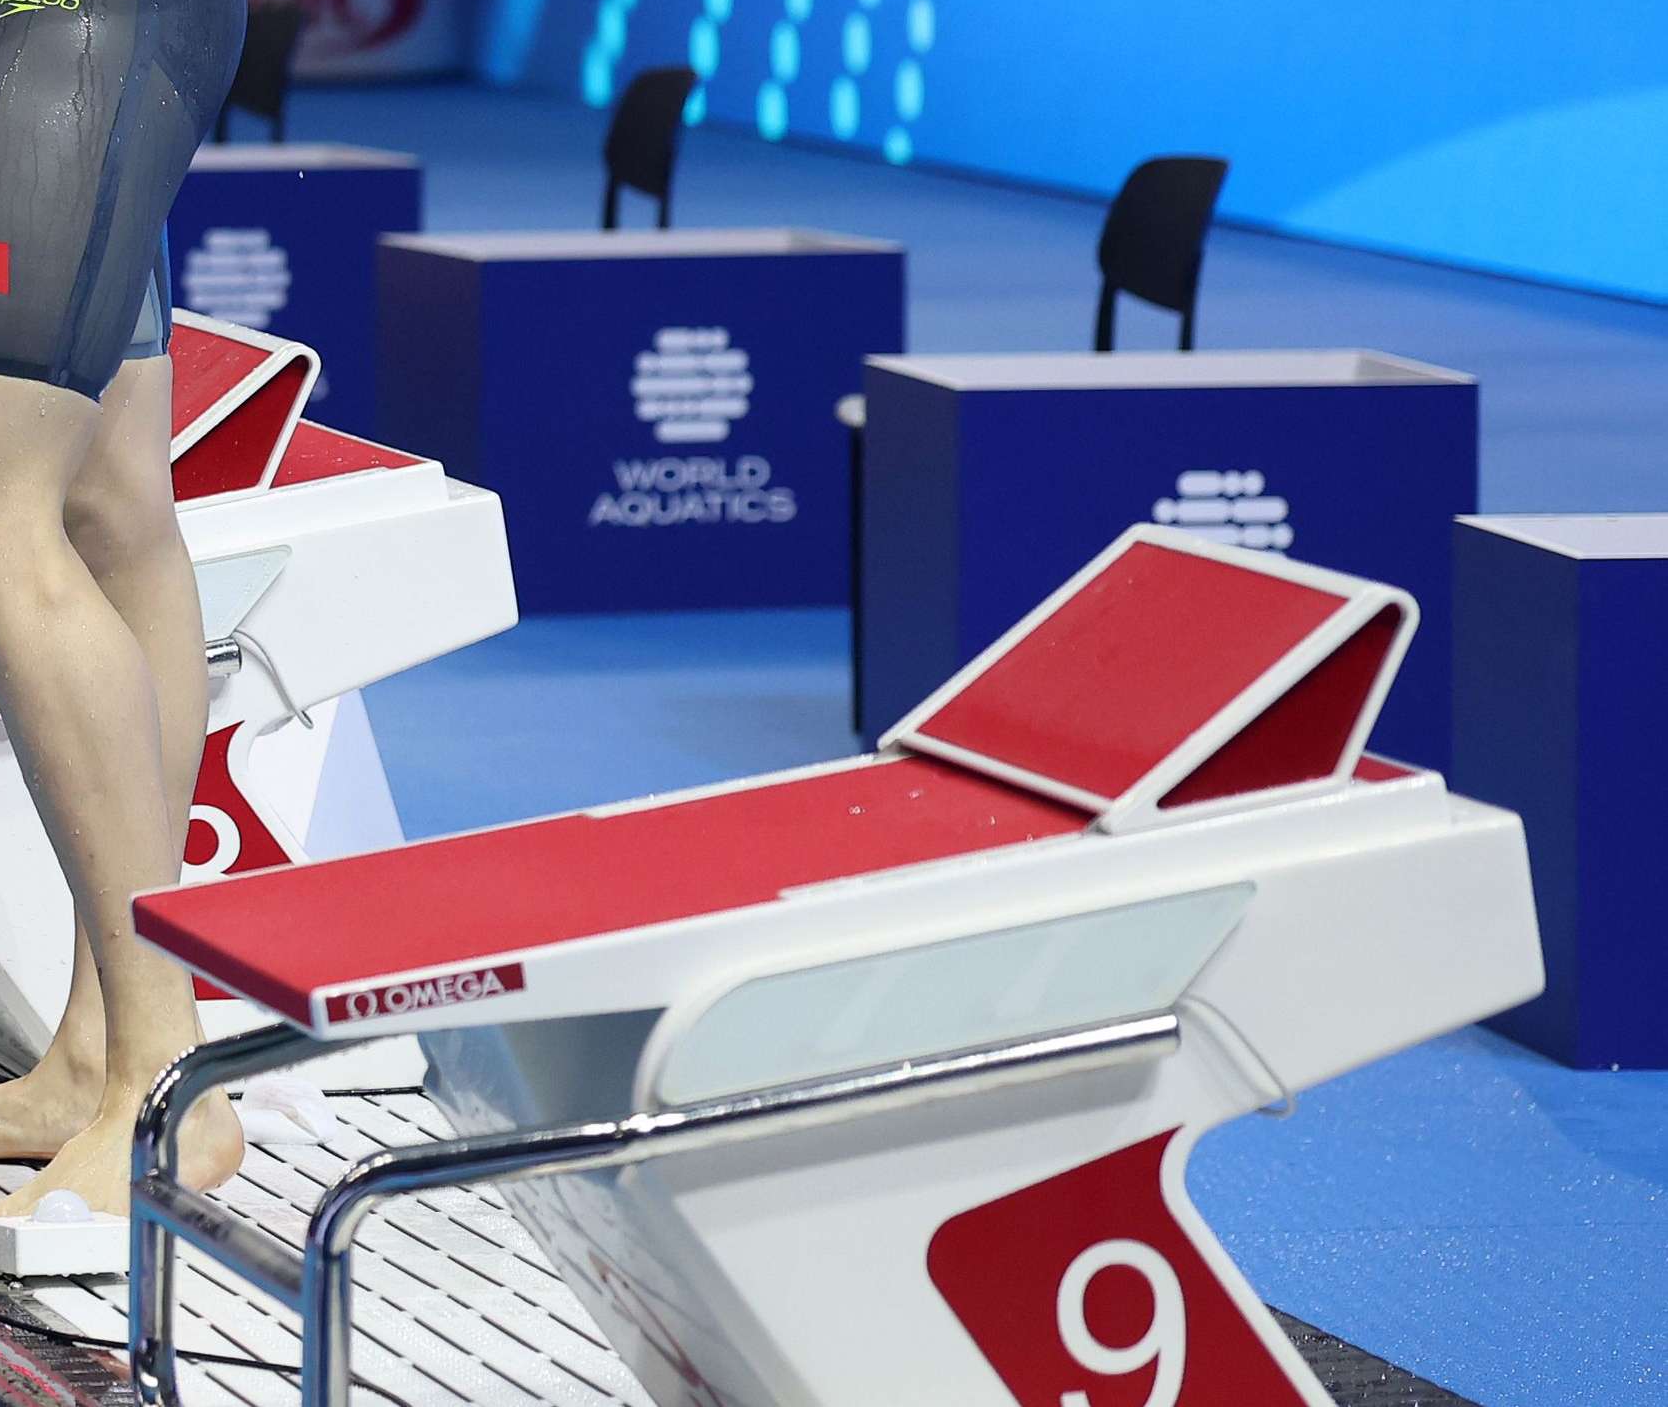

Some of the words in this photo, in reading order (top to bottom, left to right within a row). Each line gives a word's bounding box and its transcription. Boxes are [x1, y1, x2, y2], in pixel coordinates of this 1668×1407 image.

[613, 455, 772, 492] WORLD
[587, 488, 798, 527] AQUATICS
[383, 968, 506, 1014] OMEGA
[1056, 1238, 1187, 1407] 9
